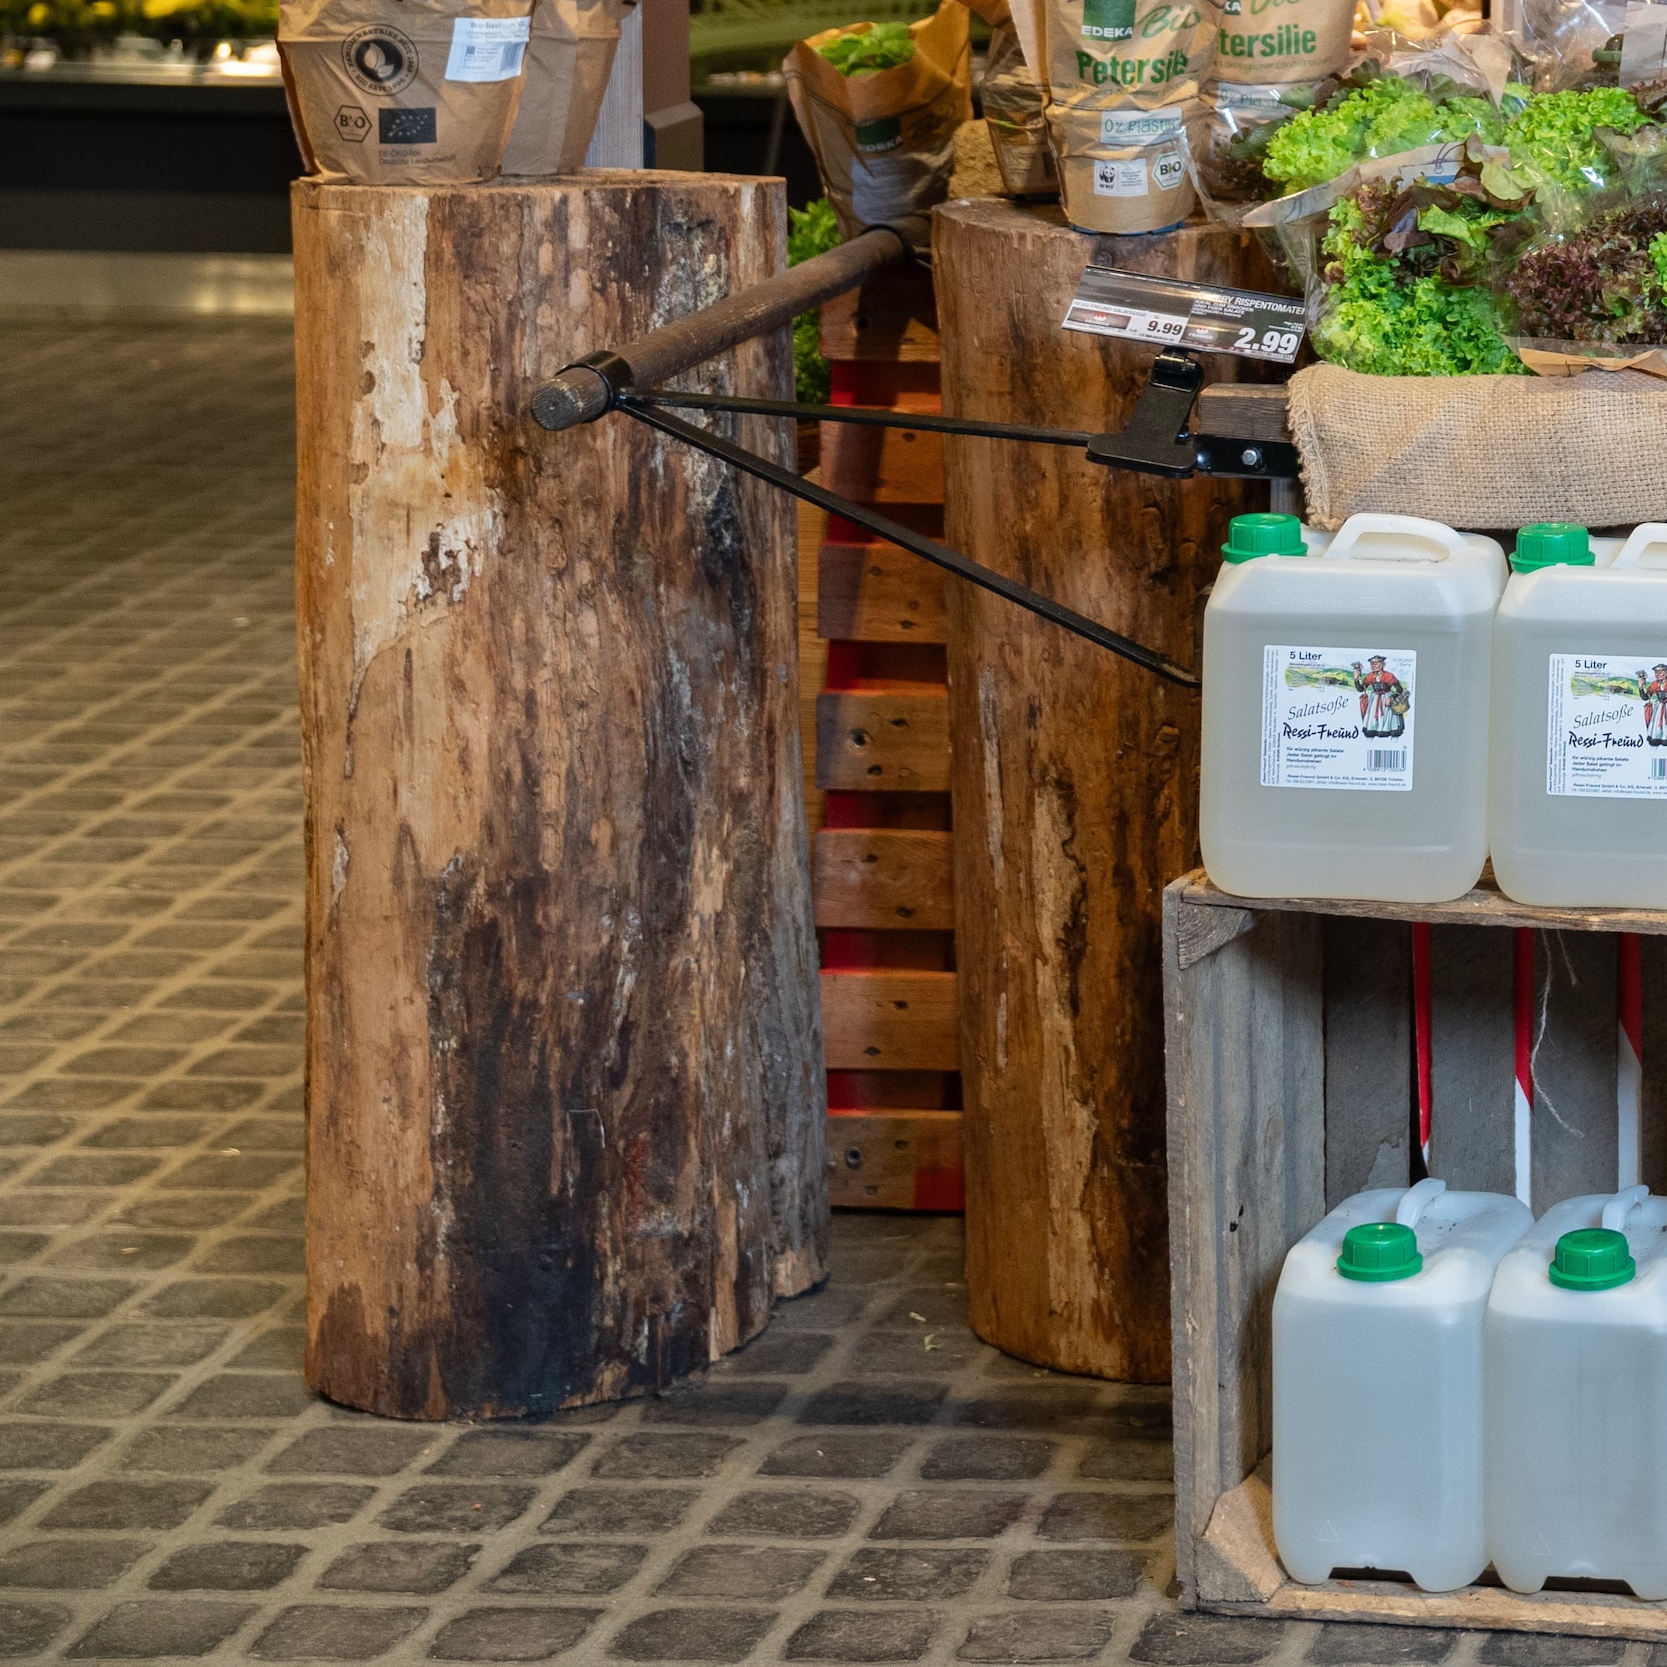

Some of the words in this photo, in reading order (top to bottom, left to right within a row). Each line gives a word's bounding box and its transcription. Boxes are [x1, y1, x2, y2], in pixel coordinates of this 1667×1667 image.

[1081, 25, 1133, 38] EDEKA
[1135, 4, 1200, 38] Bio
[1219, 23, 1317, 58] tersilie
[1076, 49, 1188, 85] Petersile
[1147, 320, 1183, 336] 9.99
[1234, 328, 1298, 354] 2.99
[1289, 651, 1296, 660] 5
[1299, 651, 1322, 660] Liter
[1575, 660, 1581, 668] 5
[1584, 660, 1607, 669] Liter
[1287, 695, 1349, 720] Salatsoße
[1573, 704, 1634, 729] Salatsoße
